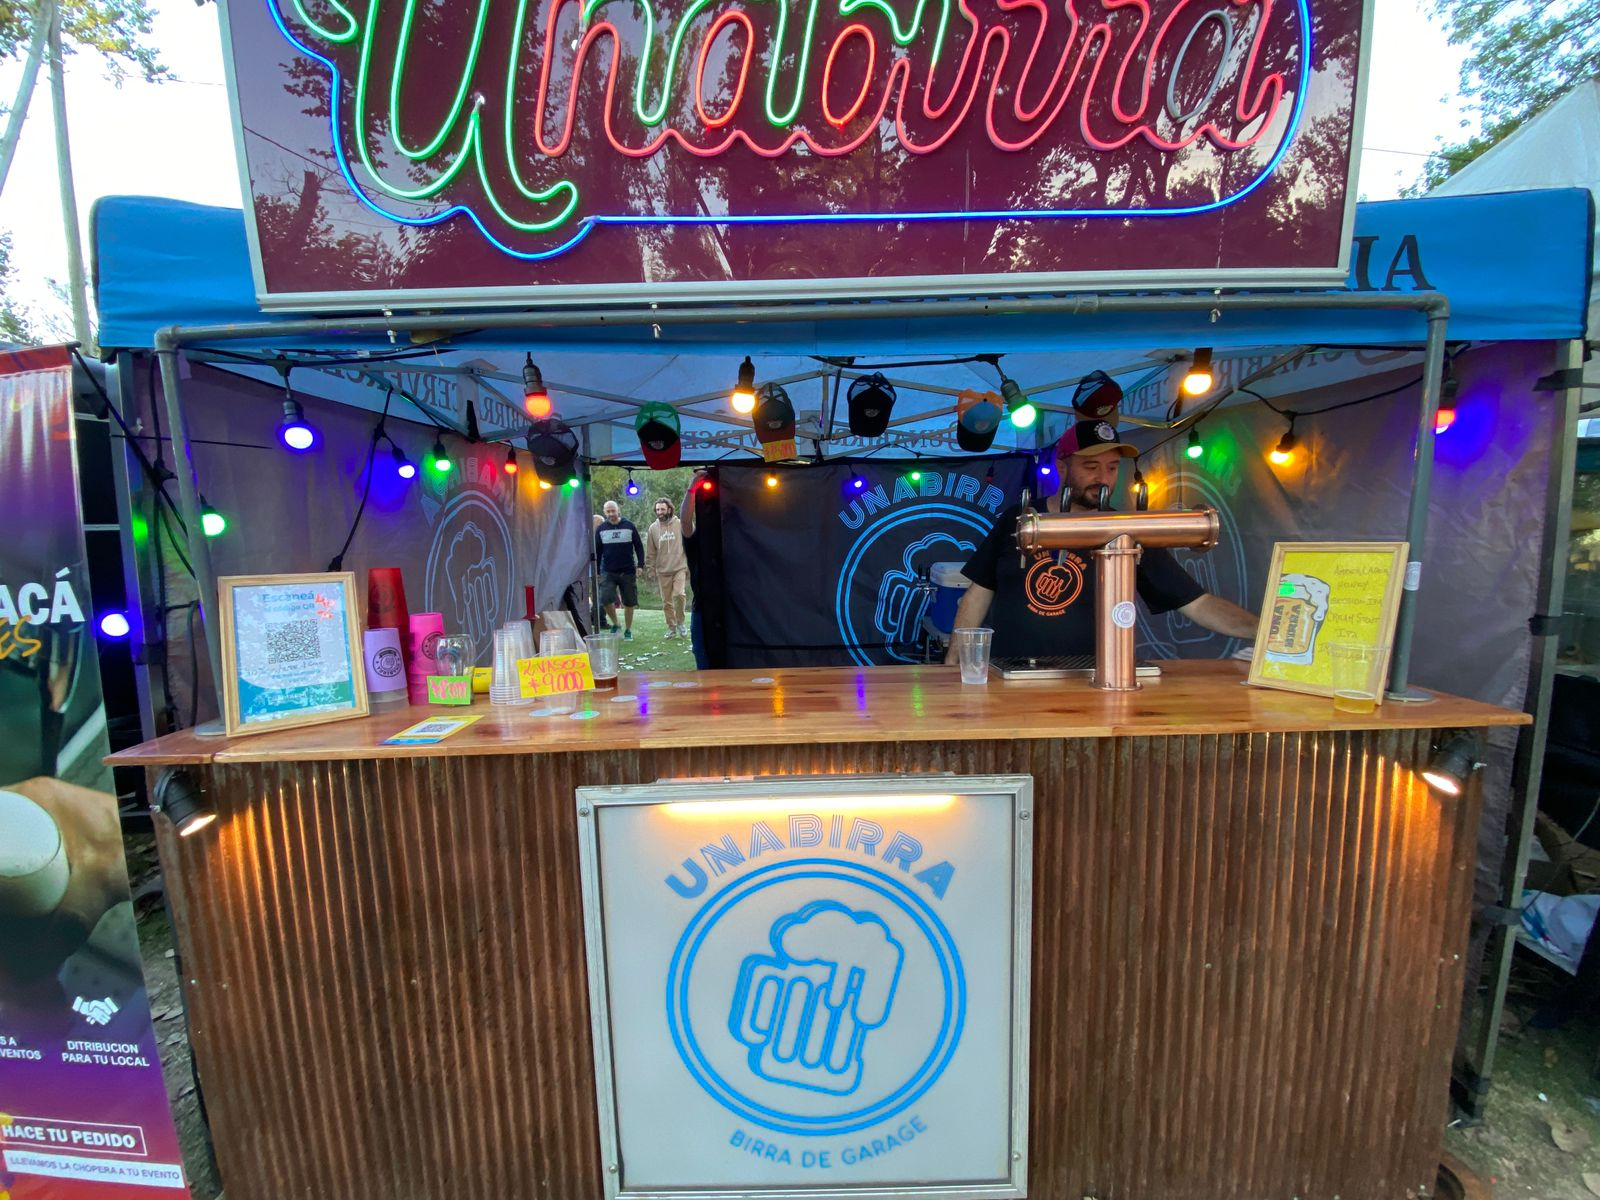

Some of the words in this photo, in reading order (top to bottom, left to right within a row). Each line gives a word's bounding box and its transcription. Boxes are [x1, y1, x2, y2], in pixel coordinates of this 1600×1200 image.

[838, 471, 1005, 529] UNABIRR
[664, 813, 956, 901] UNABIRRA
[67, 1040, 139, 1054] DITRIBUCION
[62, 1053, 91, 1064] PARA
[95, 1055, 109, 1065] TU
[111, 1056, 150, 1067] LOCAL
[2, 1125, 45, 1140] HACE
[47, 1128, 67, 1143] TU
[73, 1131, 136, 1149] PEDIDO
[729, 1129, 791, 1166] BIRRA
[801, 1150, 831, 1168] DE
[841, 1115, 928, 1166] GARAGE
[59, 1161, 71, 1171] LA
[73, 1162, 117, 1174] CHOPERA
[127, 1166, 139, 1176] TU
[142, 1168, 180, 1180] EVENTO
